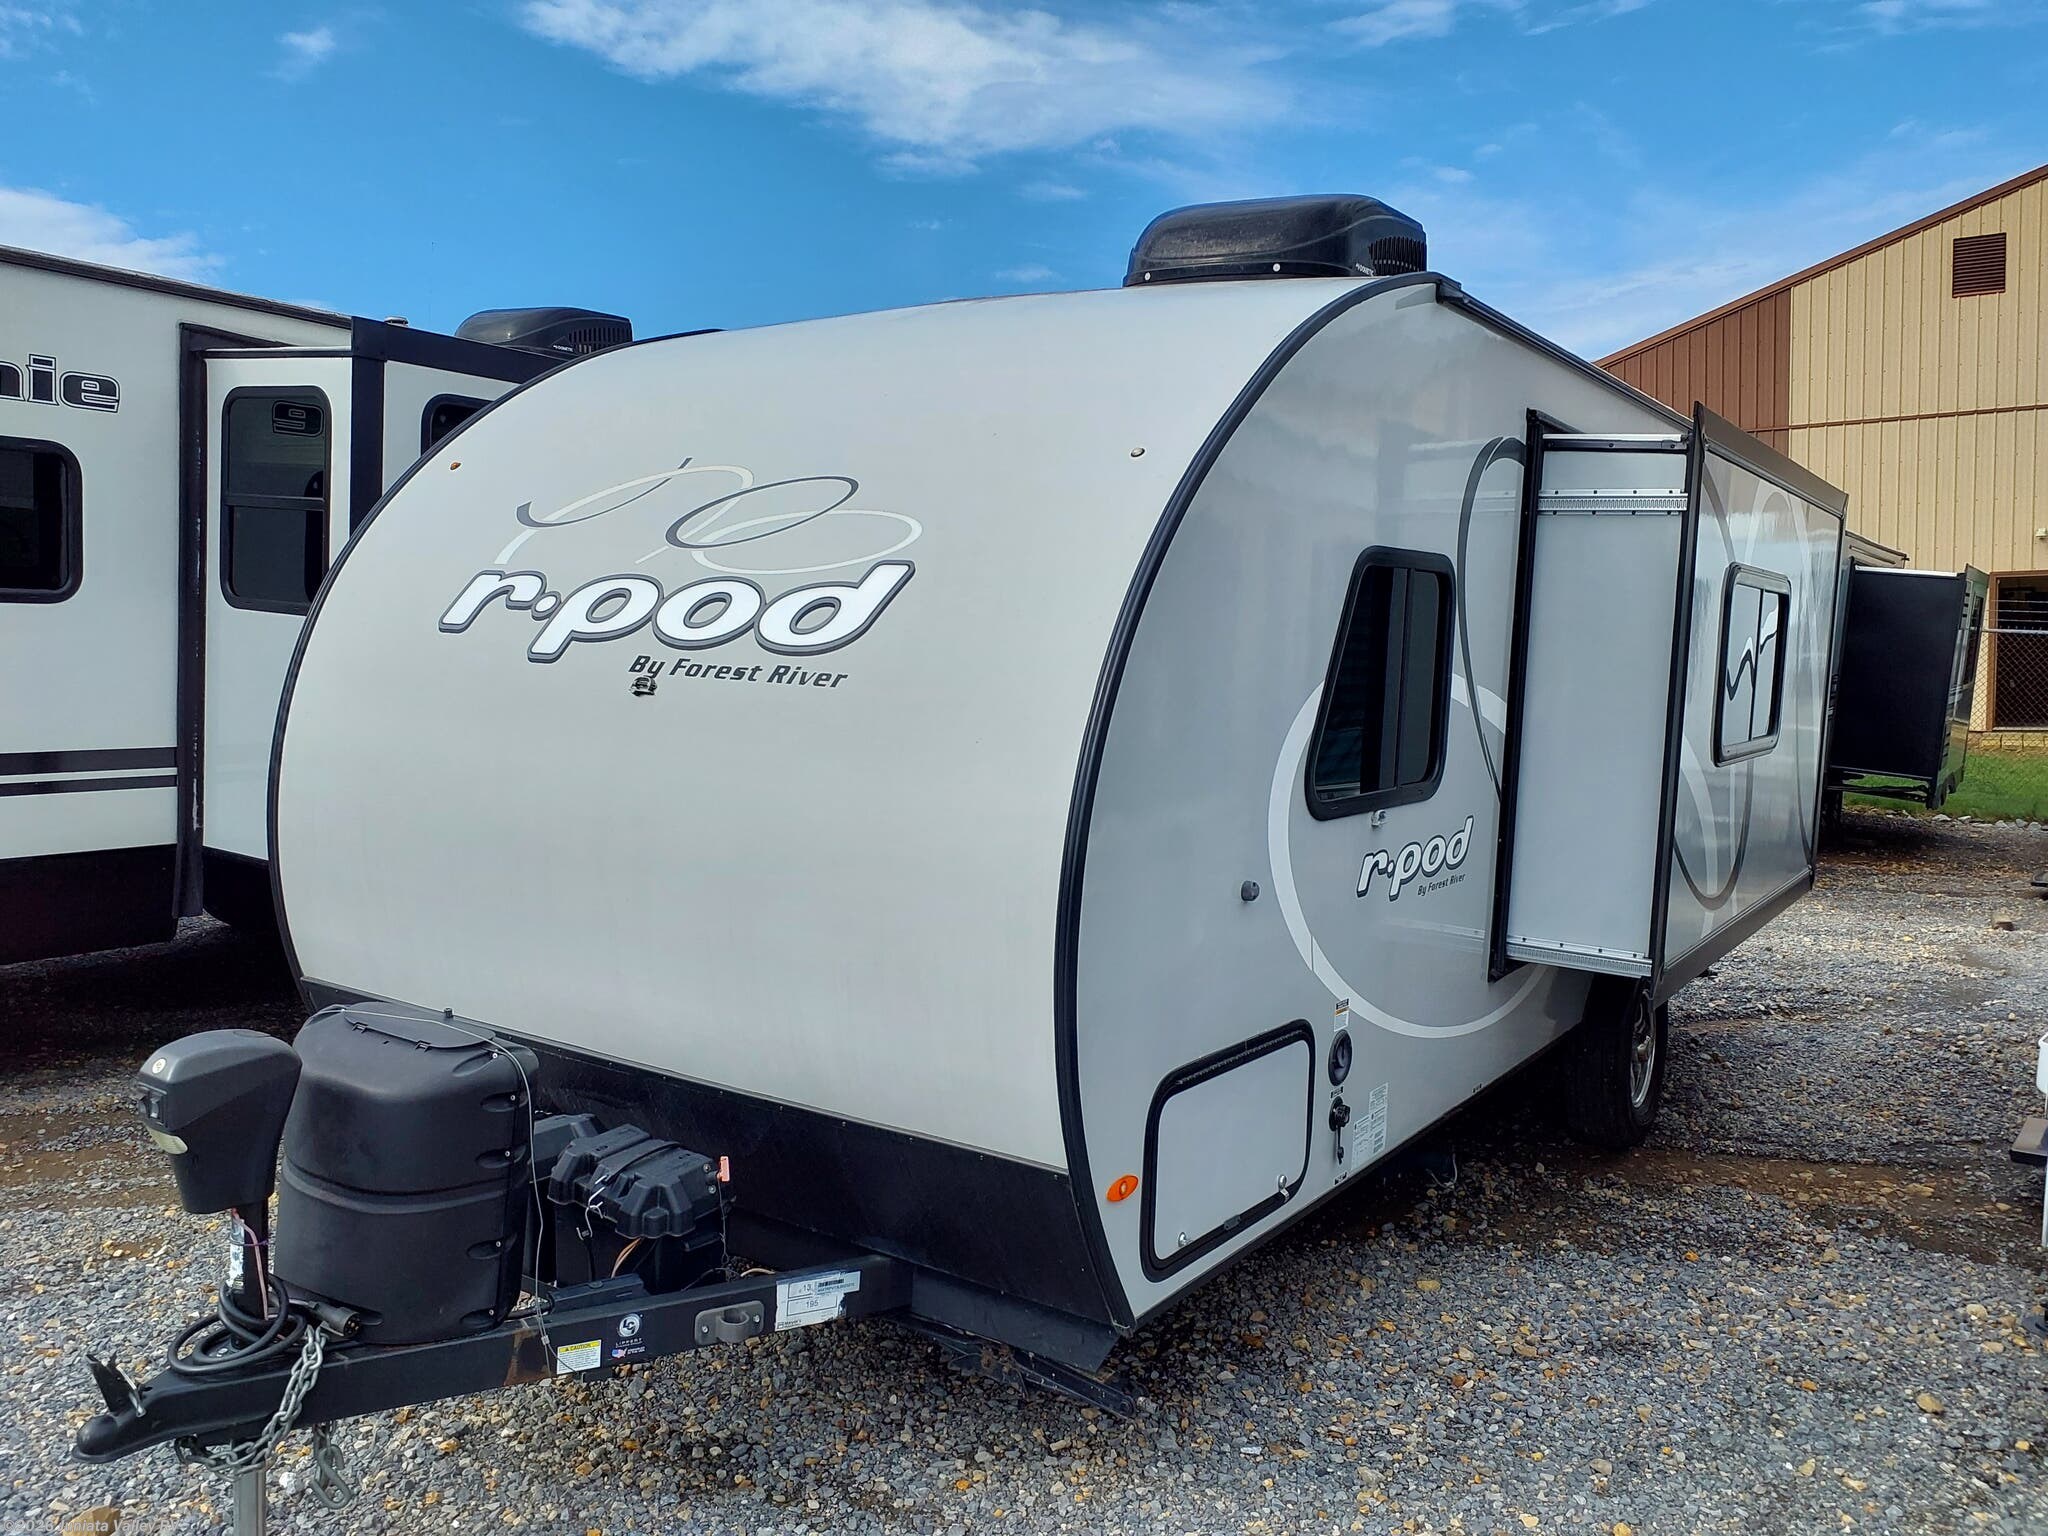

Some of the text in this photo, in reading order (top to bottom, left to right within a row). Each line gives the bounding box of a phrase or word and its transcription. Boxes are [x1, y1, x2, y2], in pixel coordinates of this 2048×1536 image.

[628, 655, 849, 688] By Forest River
[1417, 873, 1467, 896] By Forest River
